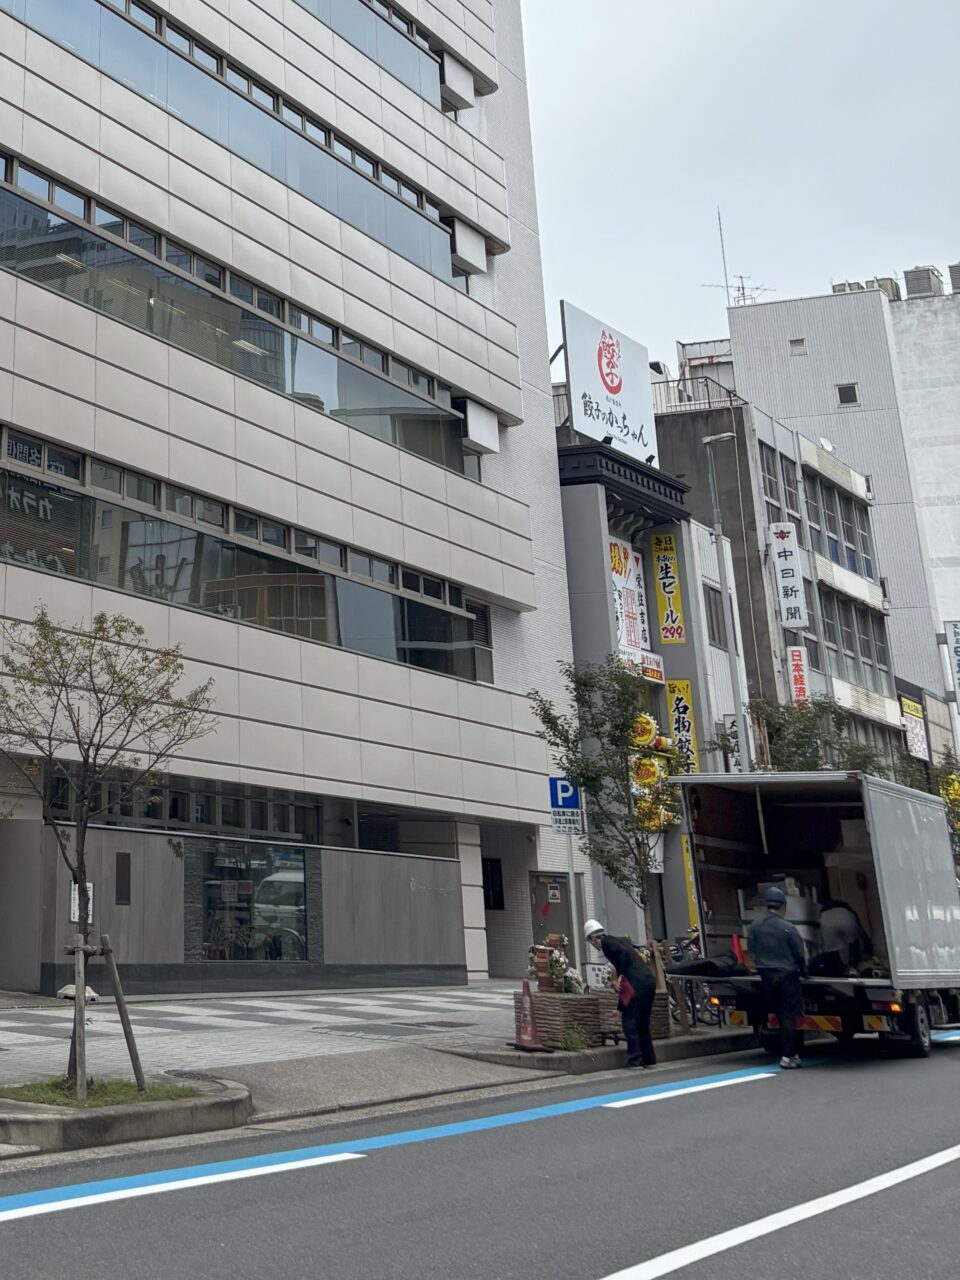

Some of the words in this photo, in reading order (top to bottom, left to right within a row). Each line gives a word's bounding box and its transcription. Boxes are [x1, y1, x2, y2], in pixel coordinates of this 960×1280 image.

[581, 392, 649, 448] 餃子のかっちゃん
[658, 563, 680, 625] 生ビール
[777, 547, 802, 621] 中日新聞
[556, 780, 574, 806] P
[555, 825, 580, 833] ここから
